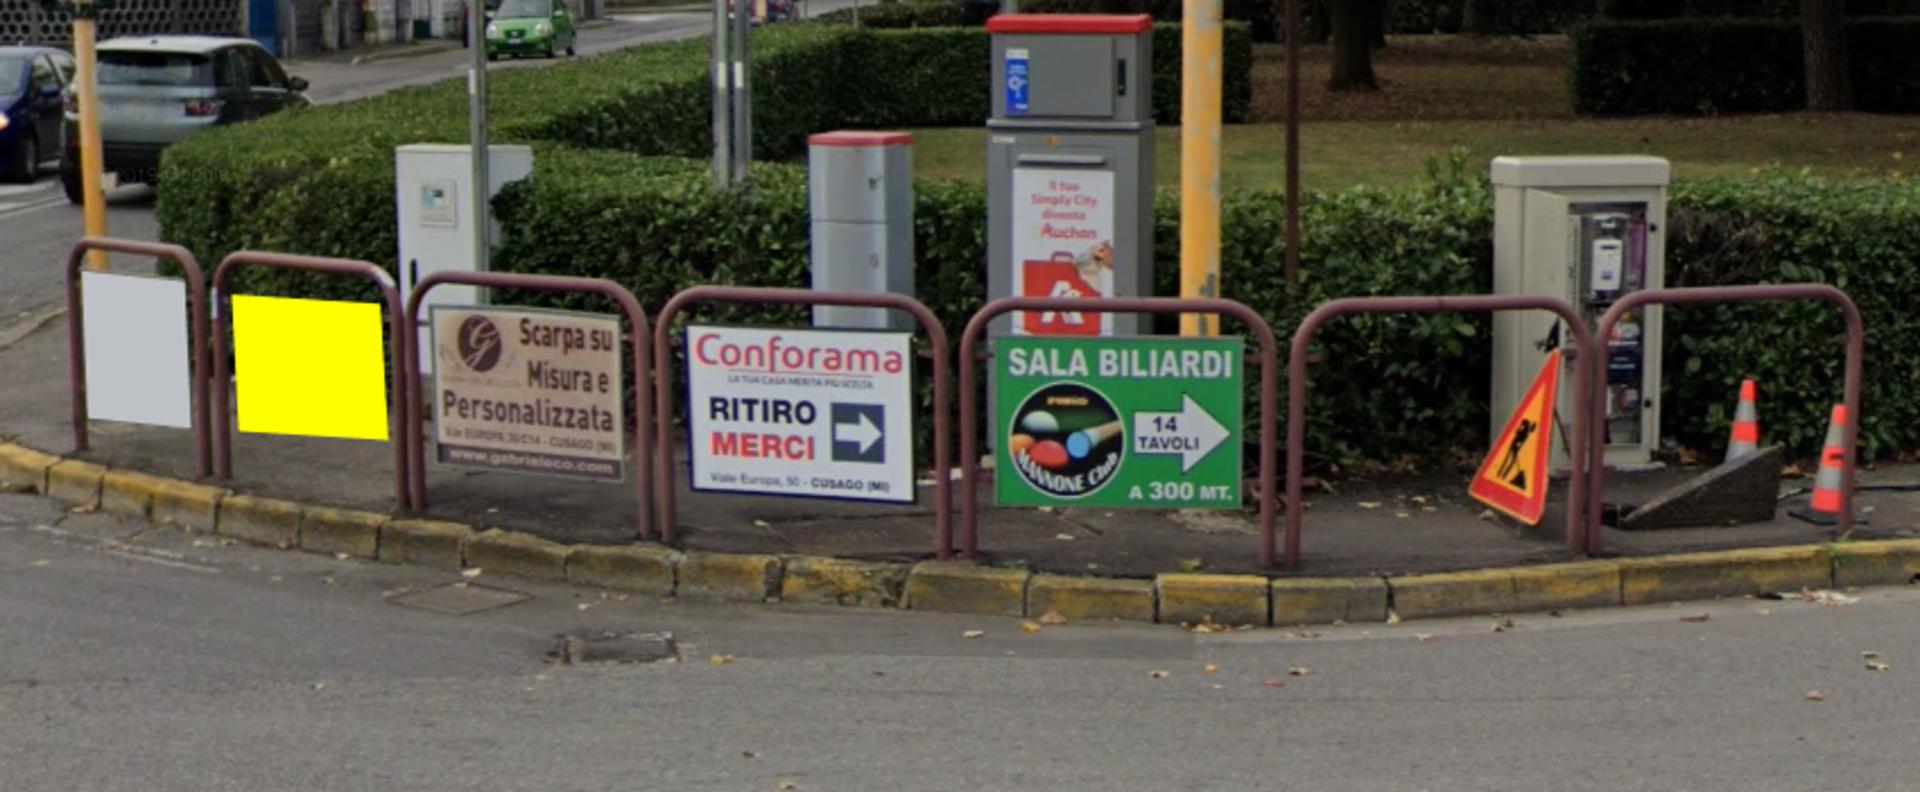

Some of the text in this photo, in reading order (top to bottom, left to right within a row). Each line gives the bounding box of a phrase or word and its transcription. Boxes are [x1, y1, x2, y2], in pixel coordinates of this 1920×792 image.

[1031, 192, 1097, 208] Simply City
[1040, 223, 1097, 240] Auchan
[518, 317, 613, 355] Scarpa su
[694, 333, 903, 374] Conforama
[1008, 348, 1233, 378] SALA BILIARDI
[527, 359, 594, 393] Misura
[598, 371, 610, 395] e
[741, 375, 760, 385] TUA
[761, 376, 786, 386] CASA
[788, 376, 822, 387] MERITA
[442, 388, 614, 433] Personalizzata
[709, 396, 816, 425] RITIRO
[1152, 416, 1178, 433] 14
[463, 427, 505, 442] EUROPA
[549, 436, 594, 450] CUSAGO
[710, 431, 815, 461] MERCI
[1138, 435, 1200, 450] TAVOLI
[709, 472, 737, 484] Viale
[786, 476, 801, 487] 50
[810, 477, 864, 490] CUSAGO
[867, 480, 890, 493] (MI)
[1128, 482, 1233, 500] A 300 MT.
